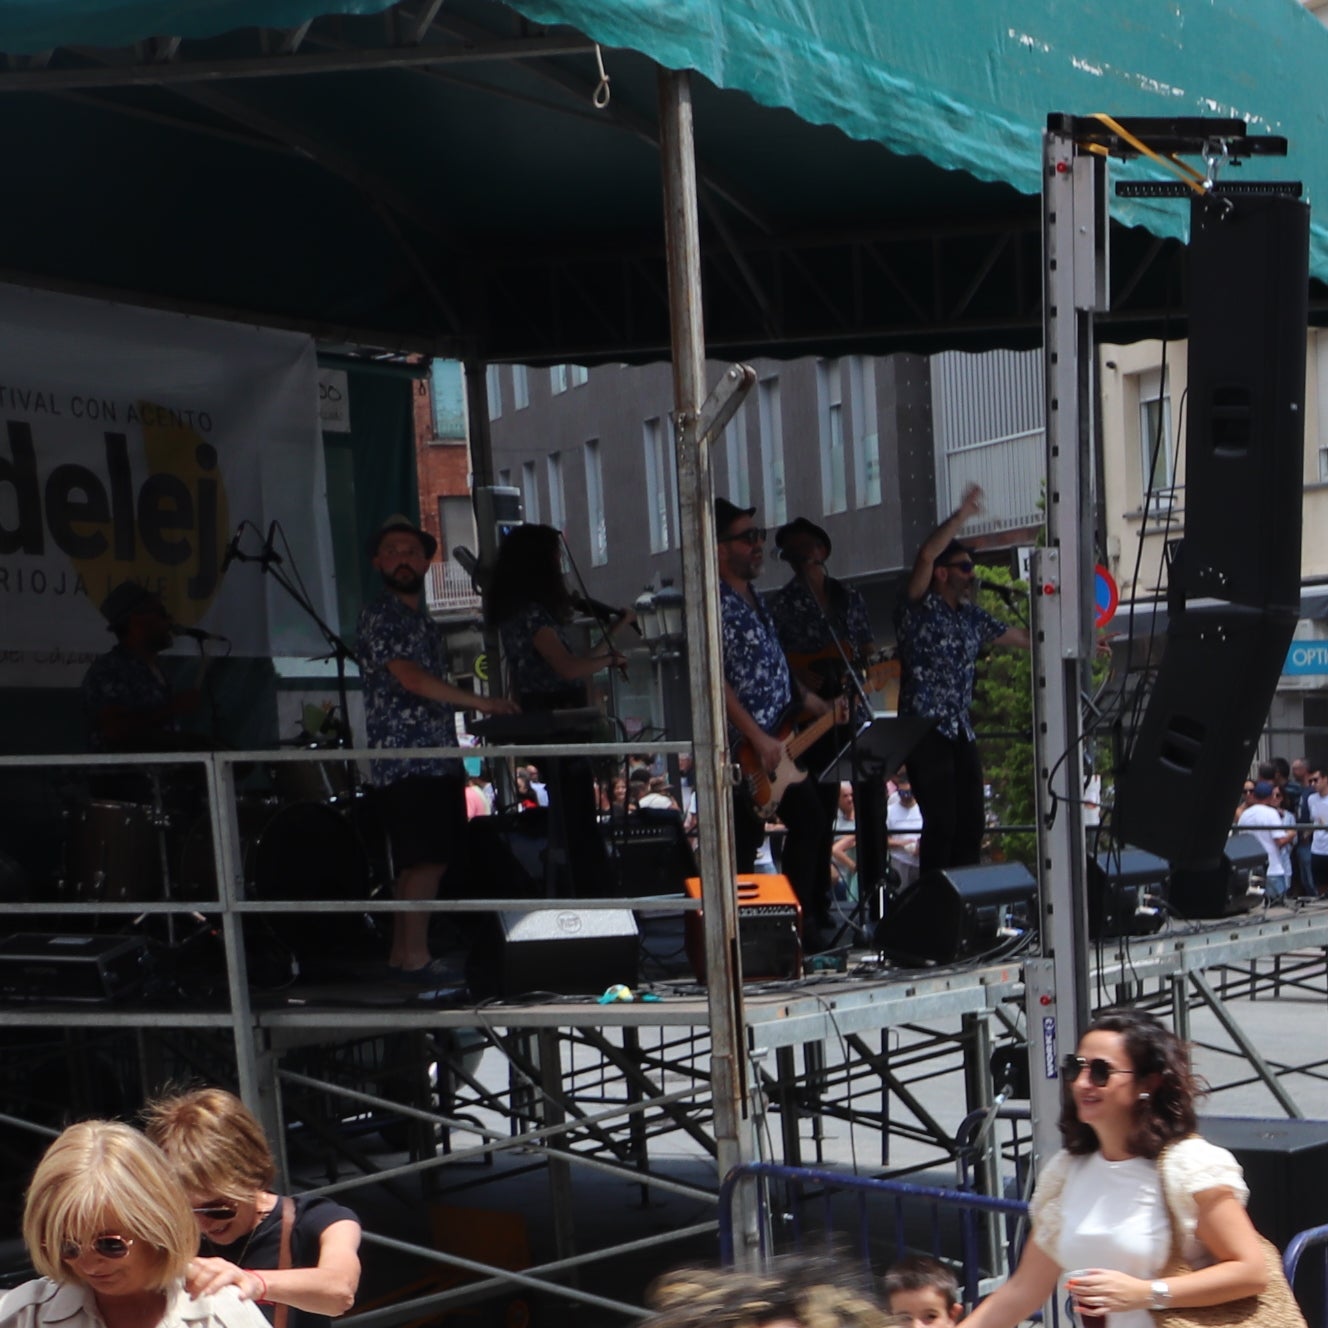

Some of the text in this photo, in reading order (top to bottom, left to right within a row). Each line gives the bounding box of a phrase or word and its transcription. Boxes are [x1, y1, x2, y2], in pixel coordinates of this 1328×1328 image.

[70, 395, 117, 424] CON
[126, 402, 213, 432] ACENTO
[0, 567, 168, 601] RIOJA LVE
